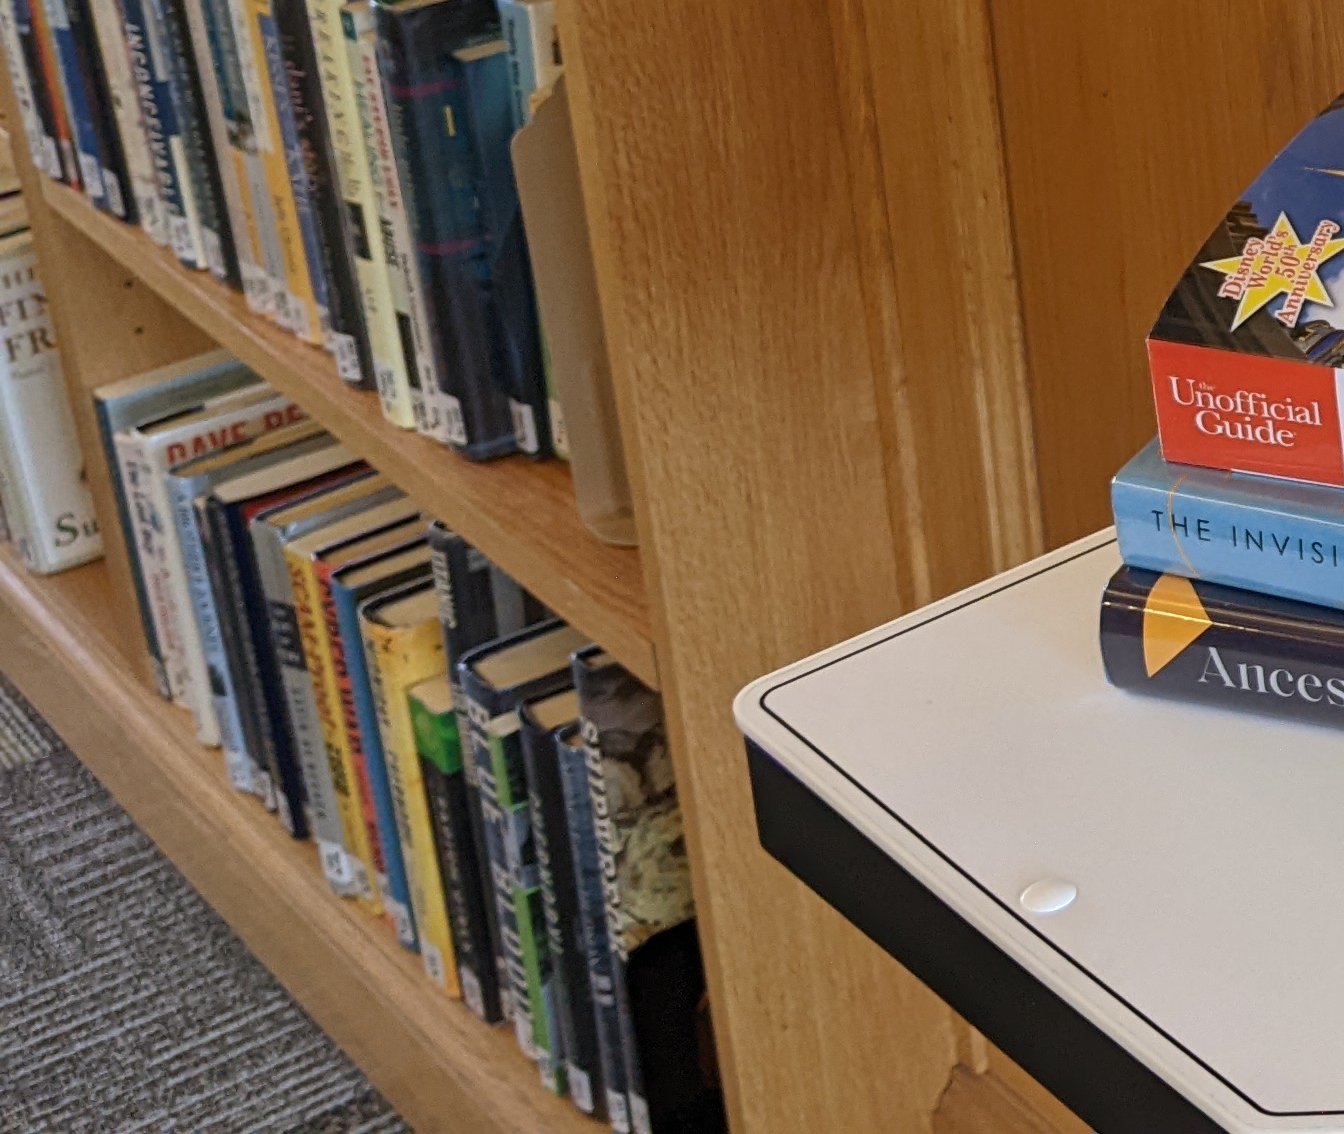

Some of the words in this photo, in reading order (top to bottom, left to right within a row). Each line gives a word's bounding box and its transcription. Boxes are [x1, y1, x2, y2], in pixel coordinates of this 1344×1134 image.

[1222, 237, 1265, 298] Disney
[1247, 230, 1290, 289] World's
[1275, 244, 1302, 279] 50th
[1276, 221, 1339, 324] Anniversary
[1168, 375, 1323, 427] Unofficial
[1194, 410, 1296, 448] Guide
[1151, 509, 1212, 542] THE
